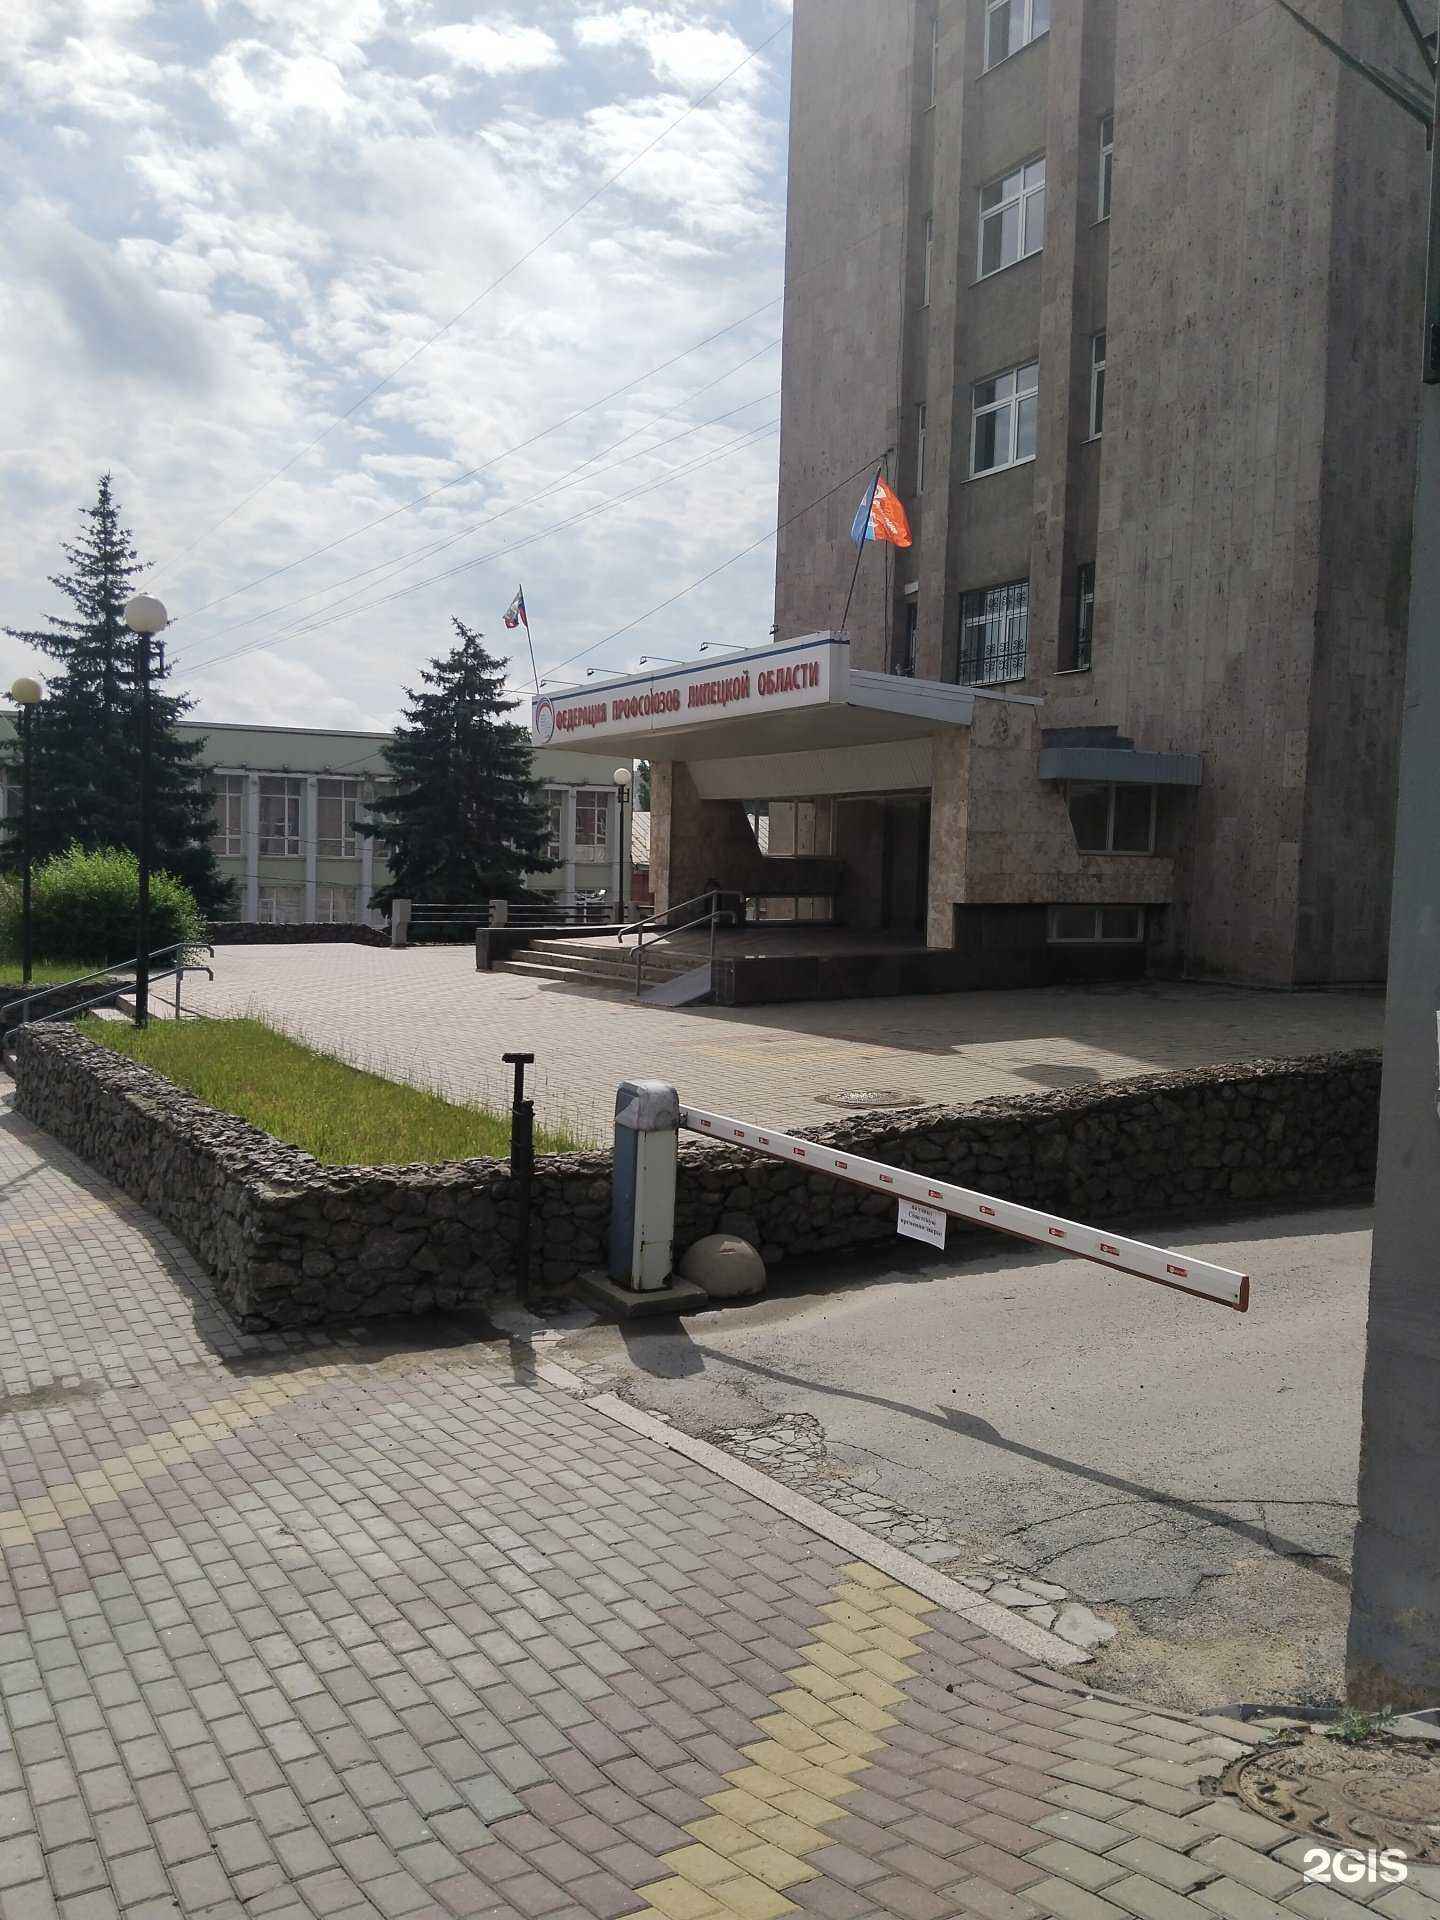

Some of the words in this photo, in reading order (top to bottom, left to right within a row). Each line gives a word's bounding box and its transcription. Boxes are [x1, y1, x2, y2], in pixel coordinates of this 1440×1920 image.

[556, 702, 608, 732] ФЕДЕРАЦИЯ
[612, 688, 681, 721] ПРОФСОЮЗОВ
[687, 670, 751, 708] ЛИПЕЦКОЙ
[757, 661, 820, 696] ОБЛАСТИ
